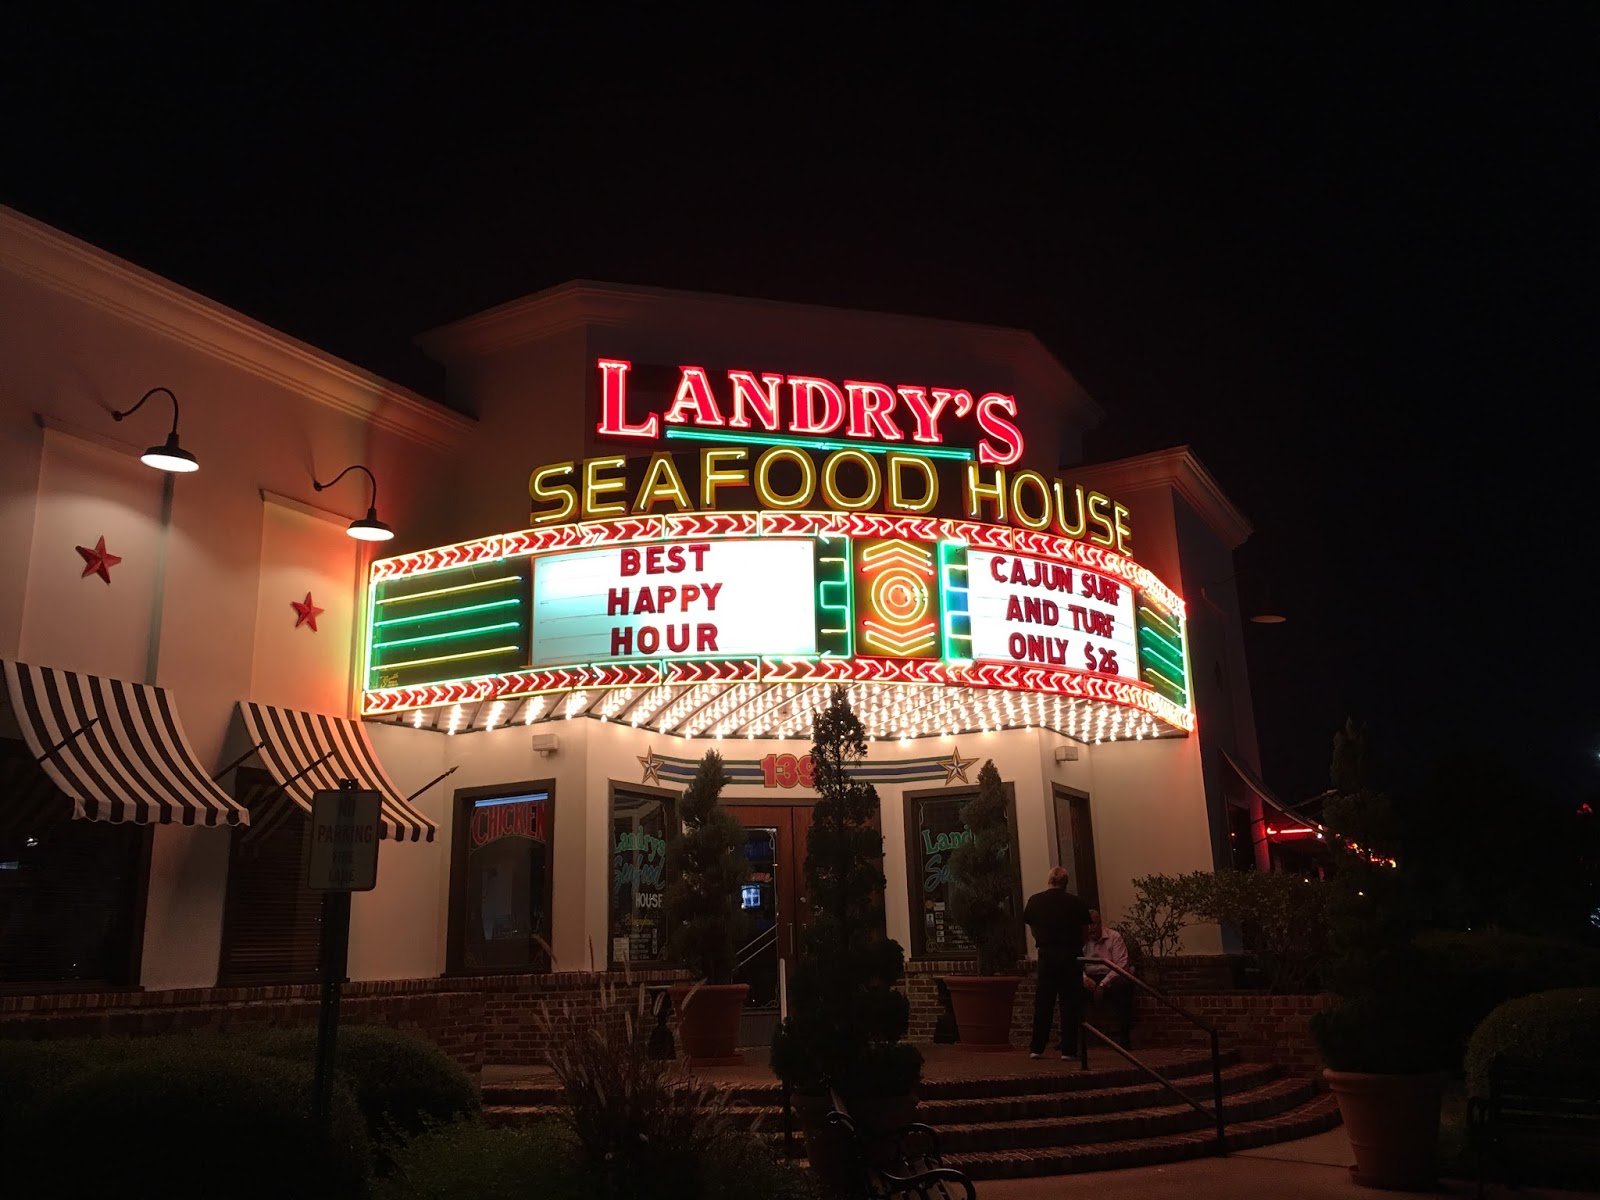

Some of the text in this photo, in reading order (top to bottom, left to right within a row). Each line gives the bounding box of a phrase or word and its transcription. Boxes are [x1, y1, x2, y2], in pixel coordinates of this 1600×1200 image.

[597, 358, 1024, 465] LANDRY'S
[529, 444, 1133, 559] SEAFOOD HOUSE
[620, 544, 711, 577] BEST
[990, 555, 1120, 606] CAJUN SURF
[607, 582, 723, 617] HAPPY
[1006, 594, 1116, 640] AND TURF
[610, 623, 719, 656] HOUR
[1008, 632, 1120, 675] ONLY $26
[317, 824, 373, 843] PARKING
[472, 801, 547, 846] CHICKEN
